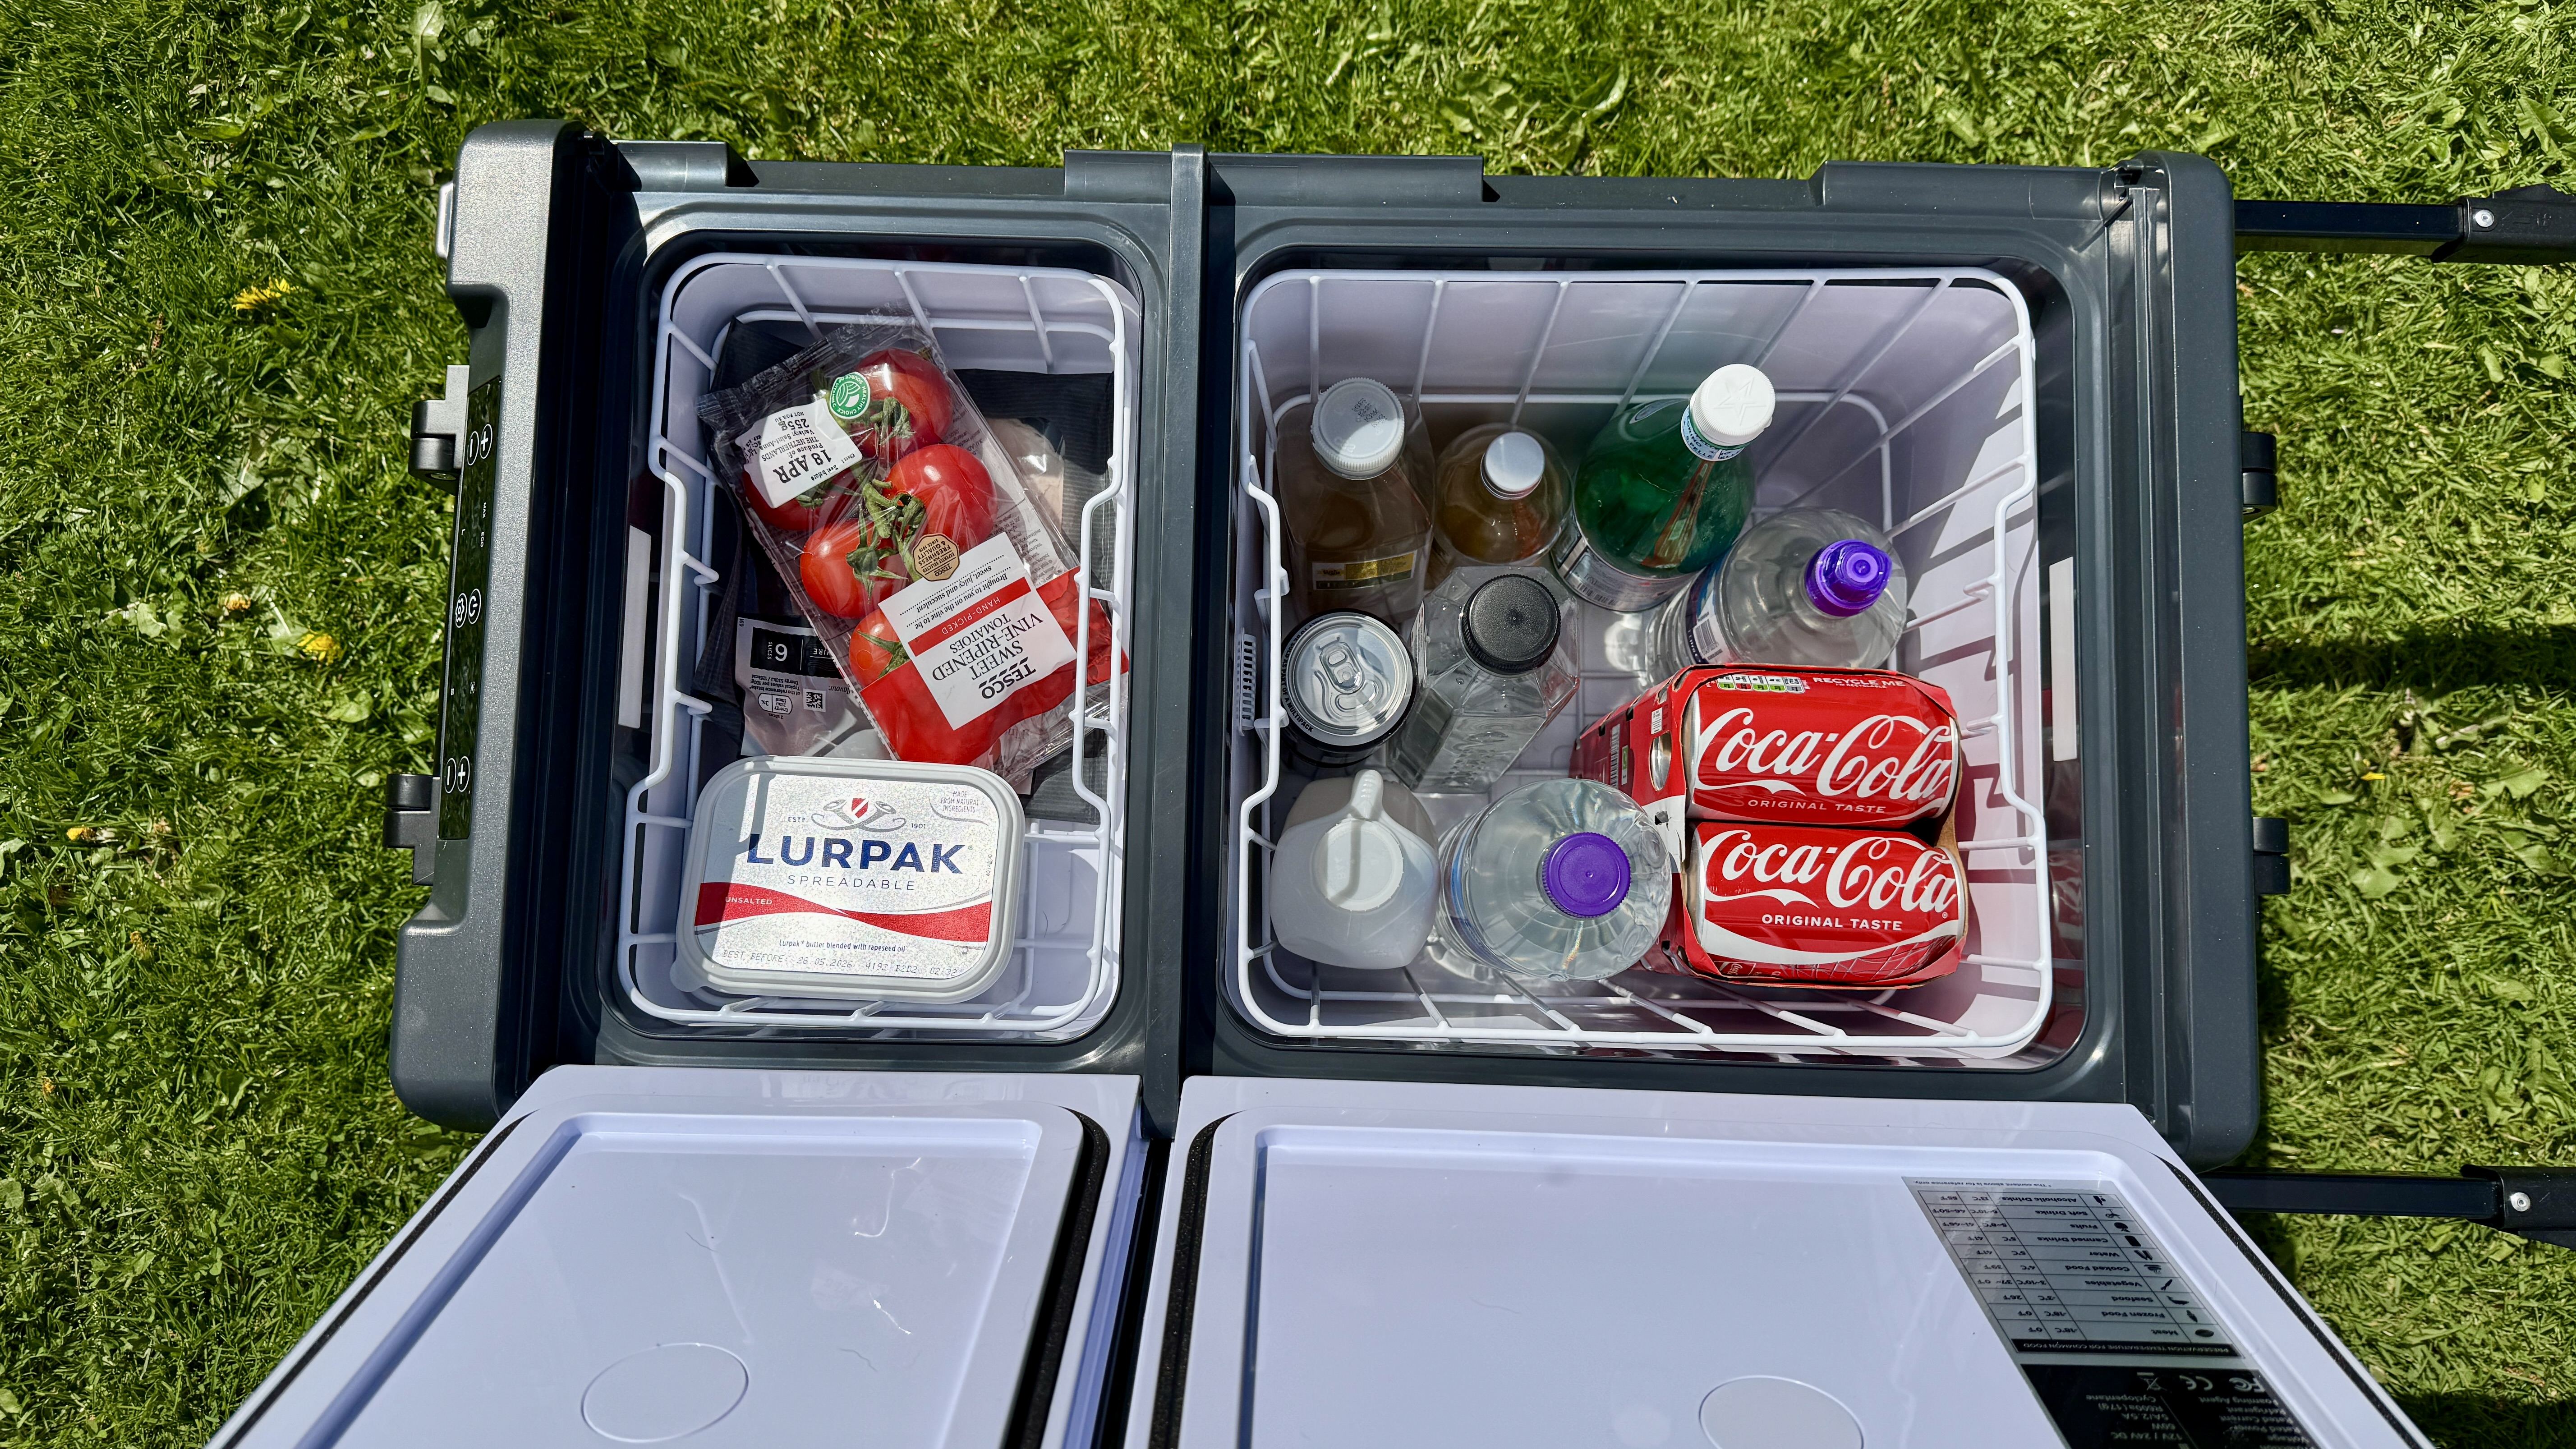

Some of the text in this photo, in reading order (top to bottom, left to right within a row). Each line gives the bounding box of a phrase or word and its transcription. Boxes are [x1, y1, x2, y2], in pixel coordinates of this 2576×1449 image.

[777, 418, 809, 432] 255g
[761, 438, 806, 462] NETHERLANDS
[796, 442, 823, 454] Produce
[773, 449, 833, 485] 18 APR
[916, 543, 941, 560] QUALITY
[918, 544, 951, 566] FRESHNESS
[934, 564, 952, 577] TESCO
[915, 564, 993, 614] sweet, juicy and succulent
[914, 571, 1008, 631] Brought to you on the vine to be
[940, 596, 1001, 635] HAND-PICKED
[948, 612, 1011, 653] TOMATOES
[775, 644, 787, 662] 6
[929, 609, 1043, 683] VINE-RIPENED
[1285, 642, 1295, 658] SOLD
[966, 639, 1024, 681] SWEET
[1282, 659, 1288, 667] AS
[979, 661, 1036, 701] TESCO
[1282, 687, 1288, 695] OF
[1287, 702, 1313, 732] MULTIPACK
[1696, 708, 1952, 801] Coca-Cola
[1748, 800, 1886, 813] ORIGINAL TASTE
[746, 833, 965, 874] LURPAK
[1702, 830, 1956, 913] Coca-Cola
[787, 875, 915, 890] SPREADABLE
[725, 897, 773, 905] UNSALTED
[1762, 914, 1902, 931] ORIGINAL TASTE
[868, 944, 895, 952] rapeseed
[2167, 1345, 2229, 1353] PRESERVATION
[2232, 1396, 2278, 1405] Foaming
[2226, 1407, 2286, 1415] Refrigerant
[2267, 1435, 2309, 1443] Voltage
